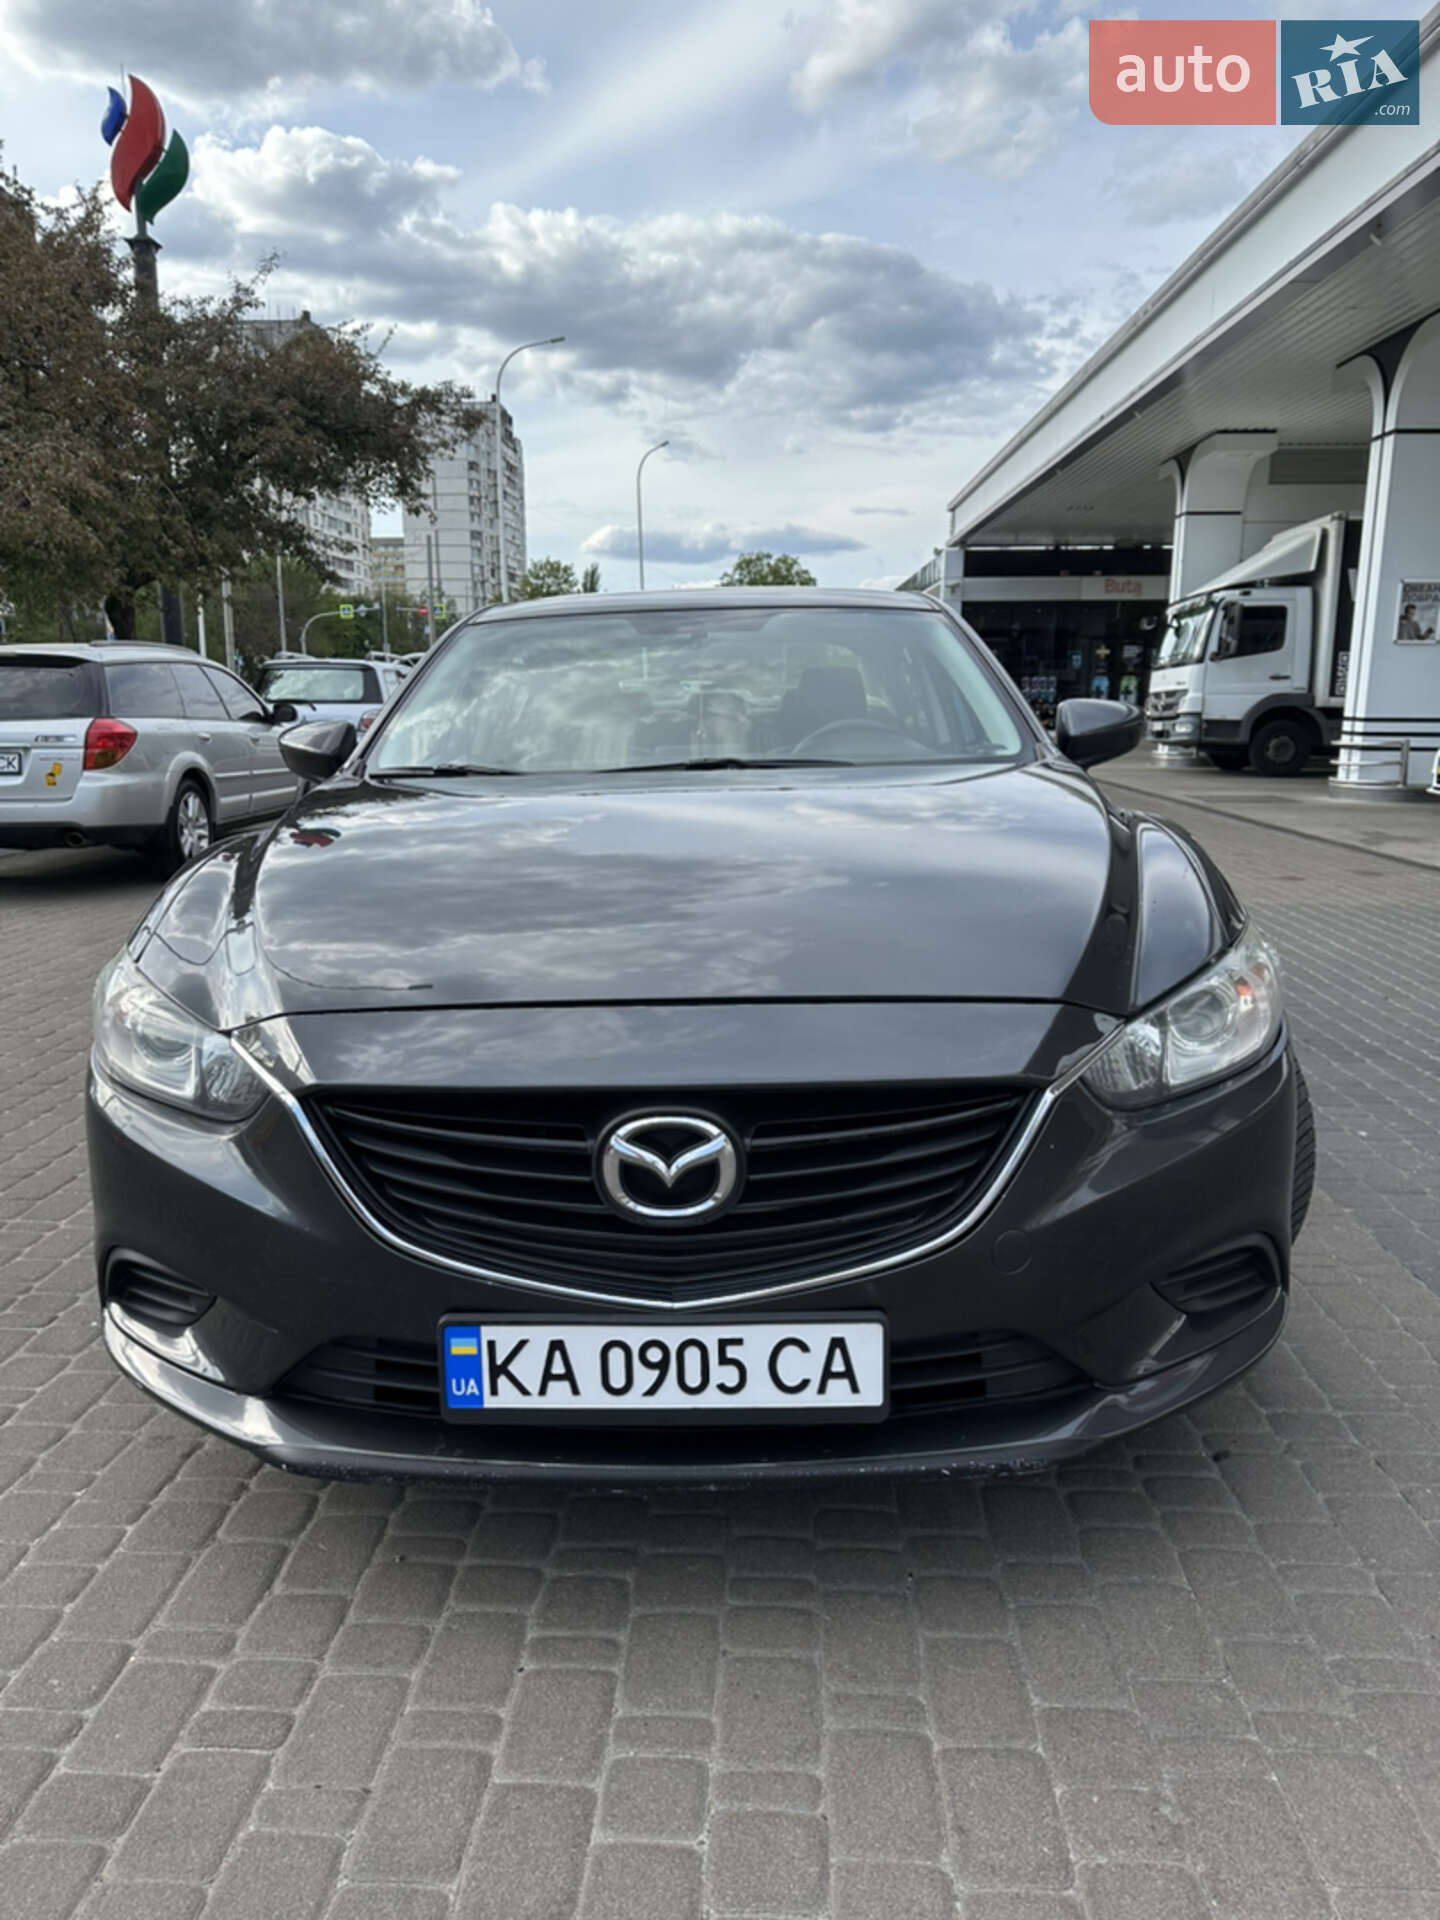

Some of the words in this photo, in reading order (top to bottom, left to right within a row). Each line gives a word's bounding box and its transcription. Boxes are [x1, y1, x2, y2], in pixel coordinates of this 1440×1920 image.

[486, 1339, 581, 1397] KA
[600, 1338, 748, 1397] 0905
[767, 1337, 861, 1396] CA
[452, 1378, 480, 1396] UA
